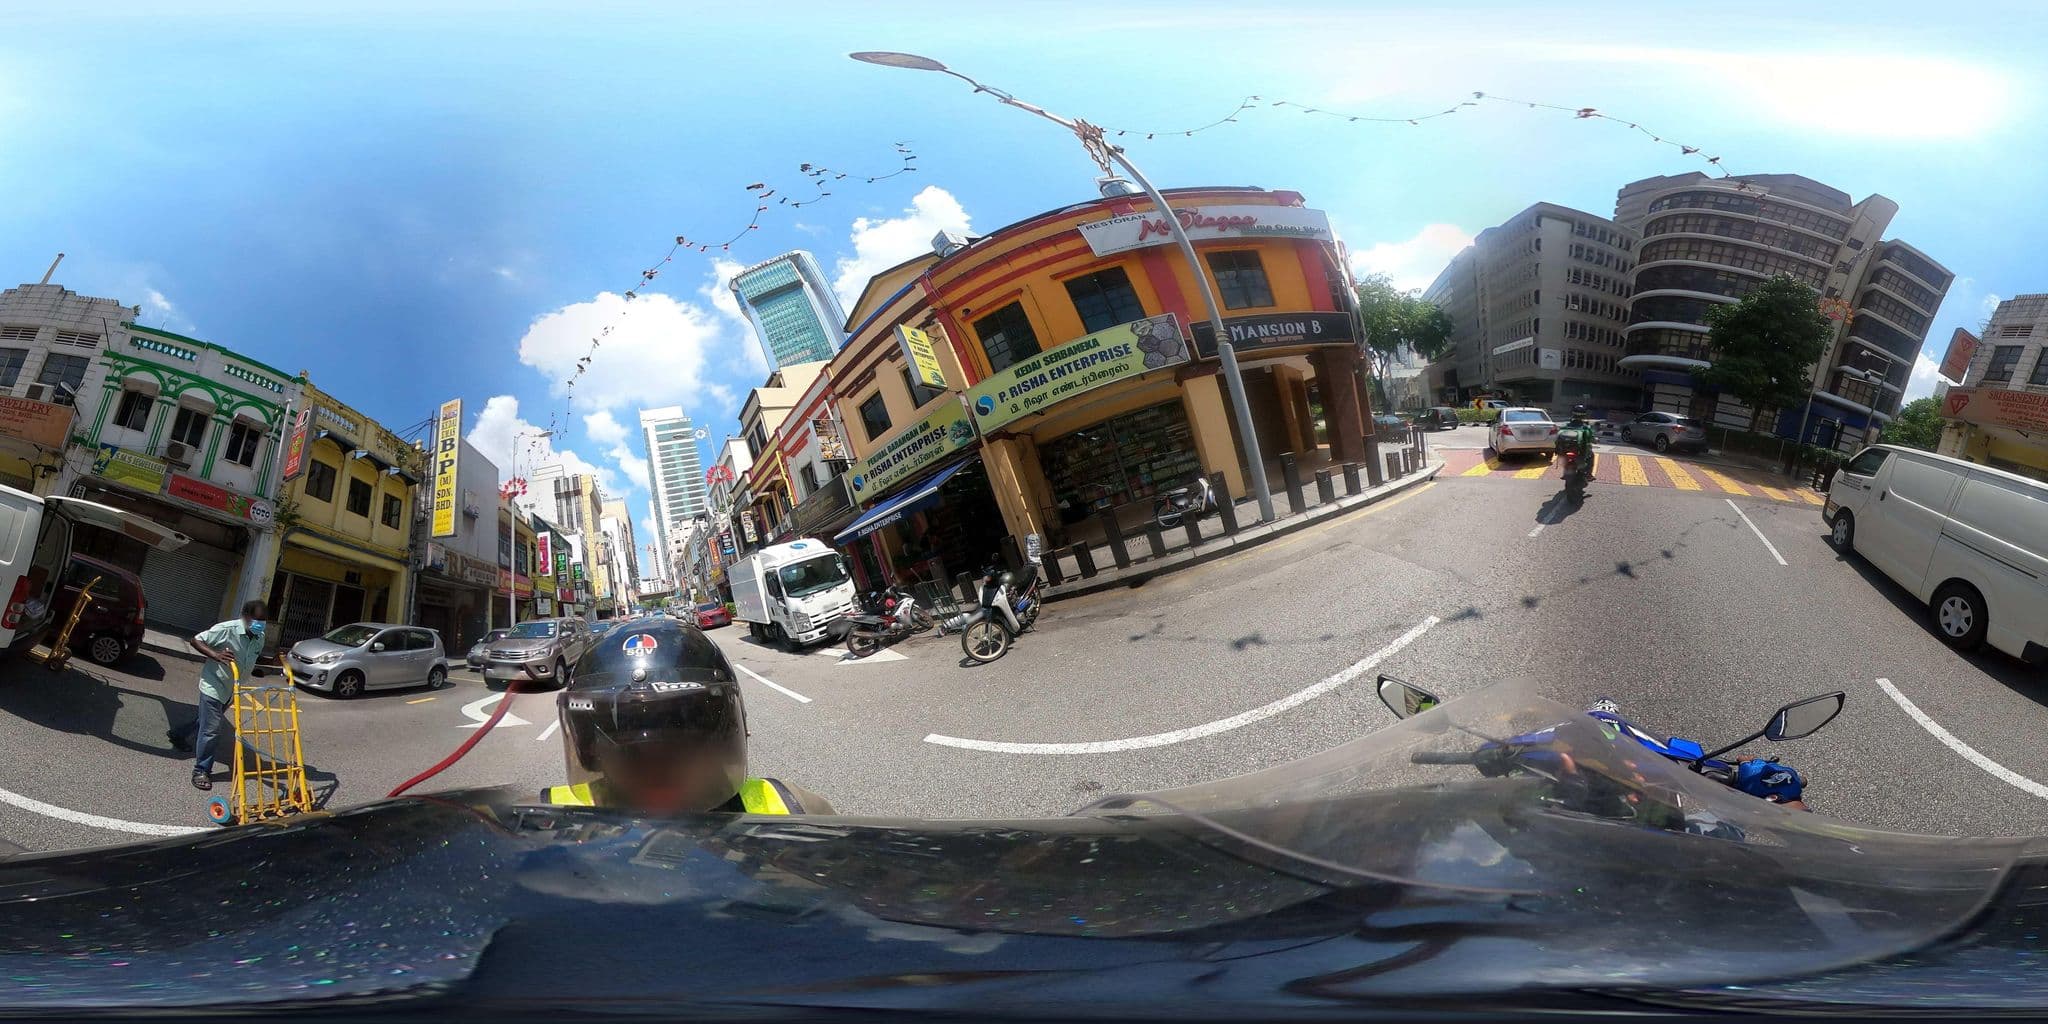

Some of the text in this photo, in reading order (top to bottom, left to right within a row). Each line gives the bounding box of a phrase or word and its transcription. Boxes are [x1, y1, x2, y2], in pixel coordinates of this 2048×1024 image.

[1085, 213, 1147, 231] RESTORAN
[1229, 320, 1307, 342] MANSION
[1311, 319, 1322, 334] B
[1014, 337, 1101, 379] KEDAI SERBANEKA
[998, 342, 1133, 404] P. RISHA ENTERPRISE
[1987, 390, 2002, 402] SRI
[2001, 390, 2042, 405] GANESH
[919, 420, 931, 435] AM
[863, 424, 948, 484] P. RISHA ENTERPRISE
[436, 487, 453, 499] SDN.
[251, 506, 271, 518] TOTO
[435, 499, 452, 511] BHD.
[873, 512, 902, 530] ENTERPRISE
